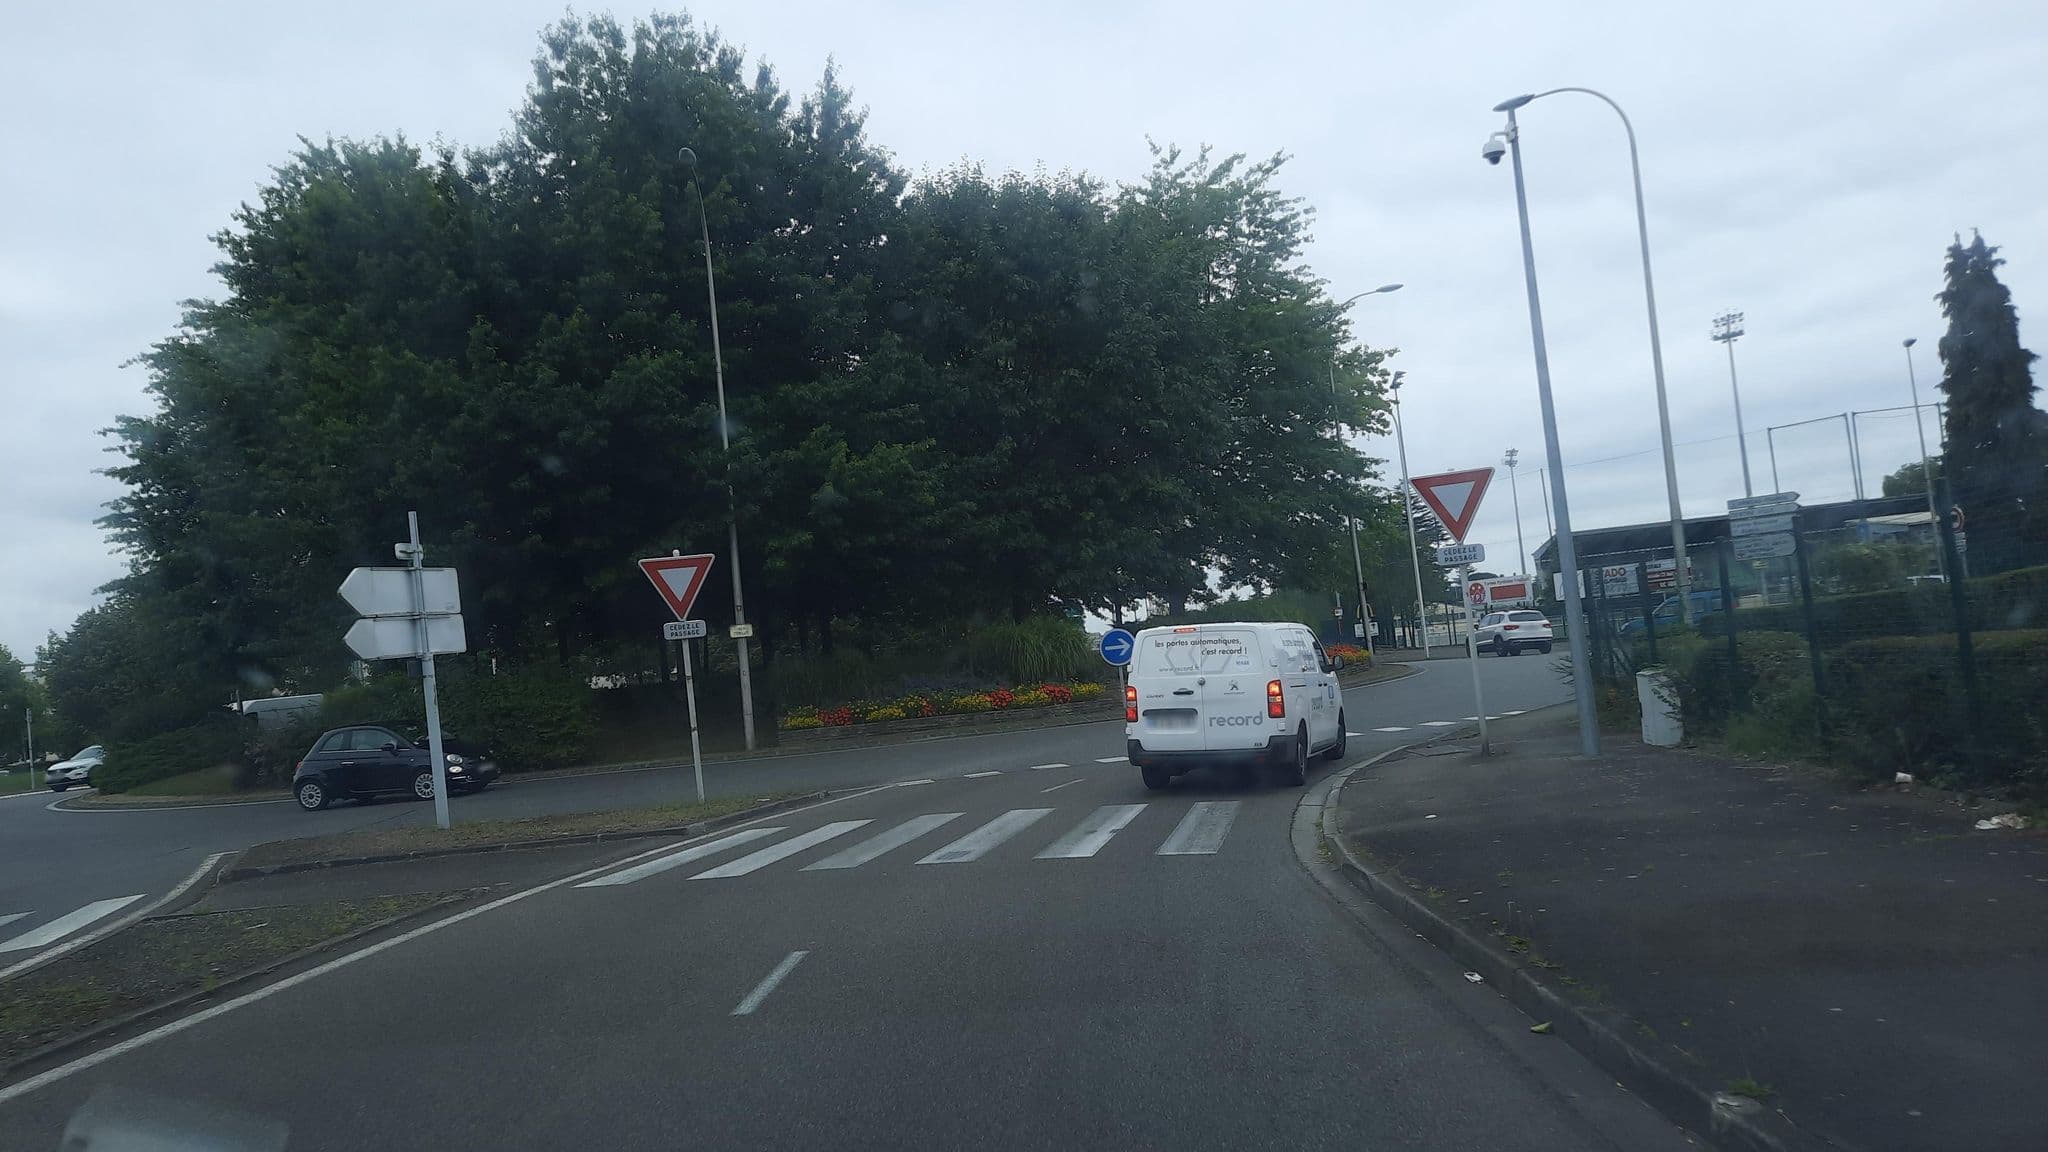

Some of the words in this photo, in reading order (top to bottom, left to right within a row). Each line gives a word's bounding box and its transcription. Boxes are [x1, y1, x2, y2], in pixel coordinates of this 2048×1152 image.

[1444, 554, 1478, 562] PASSAGE
[670, 629, 700, 637] PASSAGE
[1154, 639, 1165, 648] les
[1166, 639, 1189, 649] portes
[1190, 638, 1242, 648] automatiques,
[1201, 648, 1217, 656] c'est
[1218, 647, 1242, 656] record
[1209, 711, 1264, 727] record
